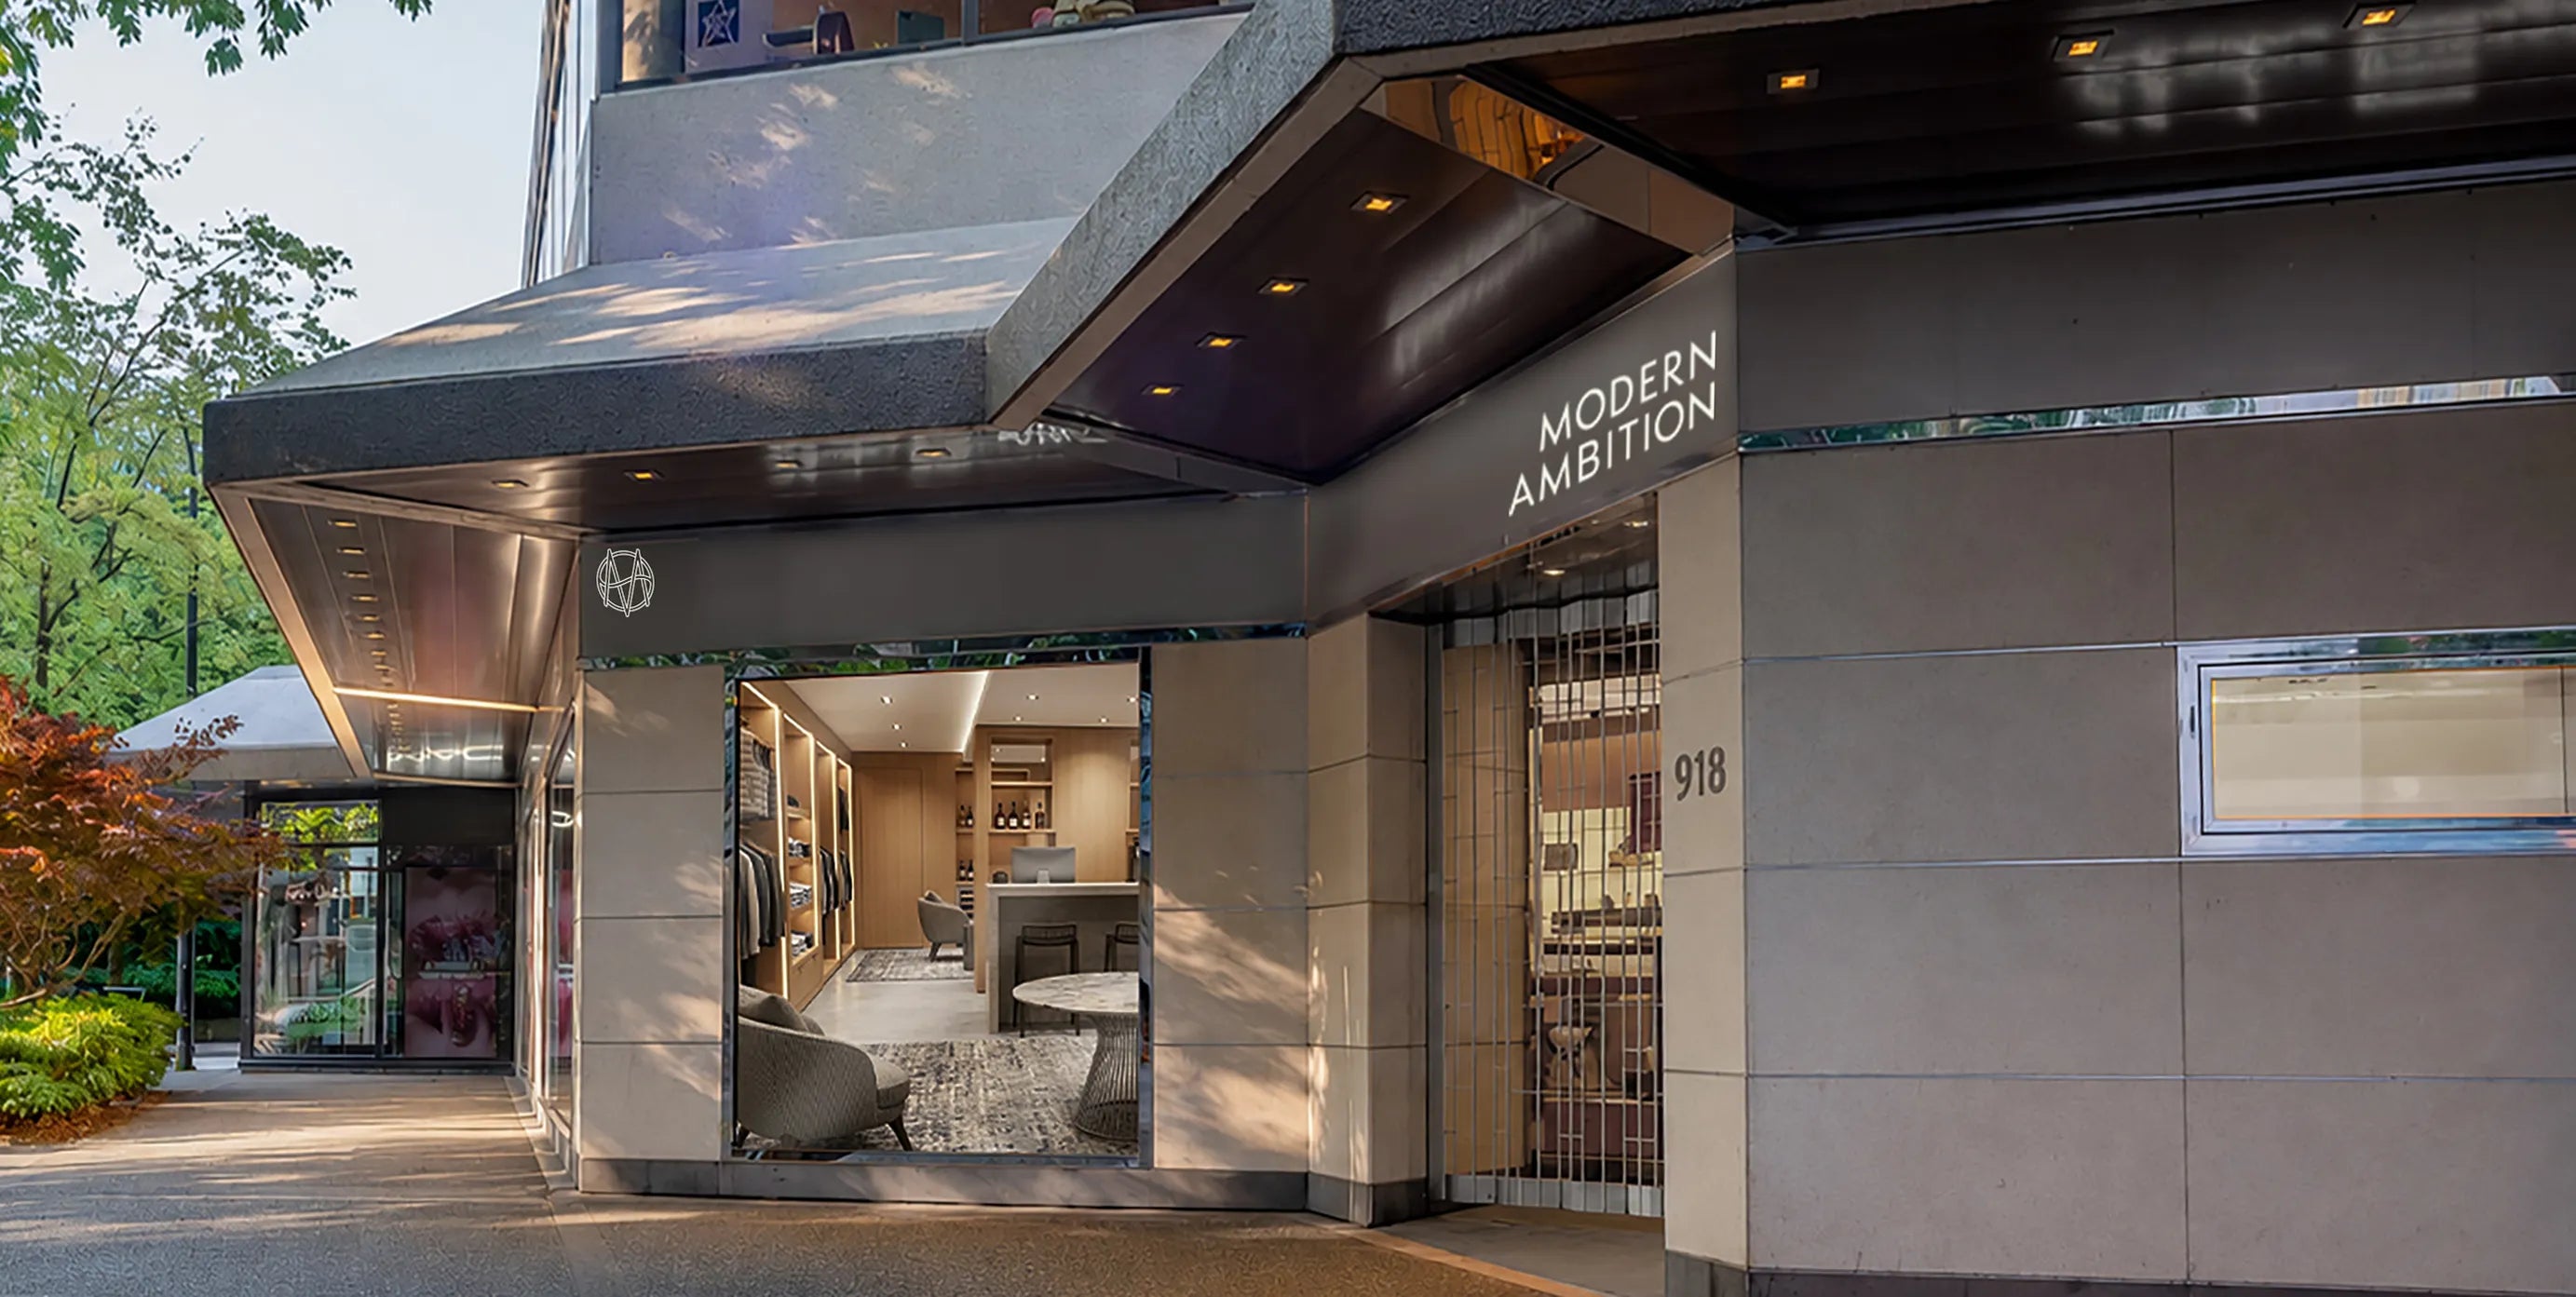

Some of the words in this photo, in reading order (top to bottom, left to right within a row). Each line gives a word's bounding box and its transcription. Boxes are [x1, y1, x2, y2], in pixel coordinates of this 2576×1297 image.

[1508, 381, 1715, 518] AMBITION
[1539, 330, 1716, 453] MODERN
[1674, 746, 1727, 802] 918
